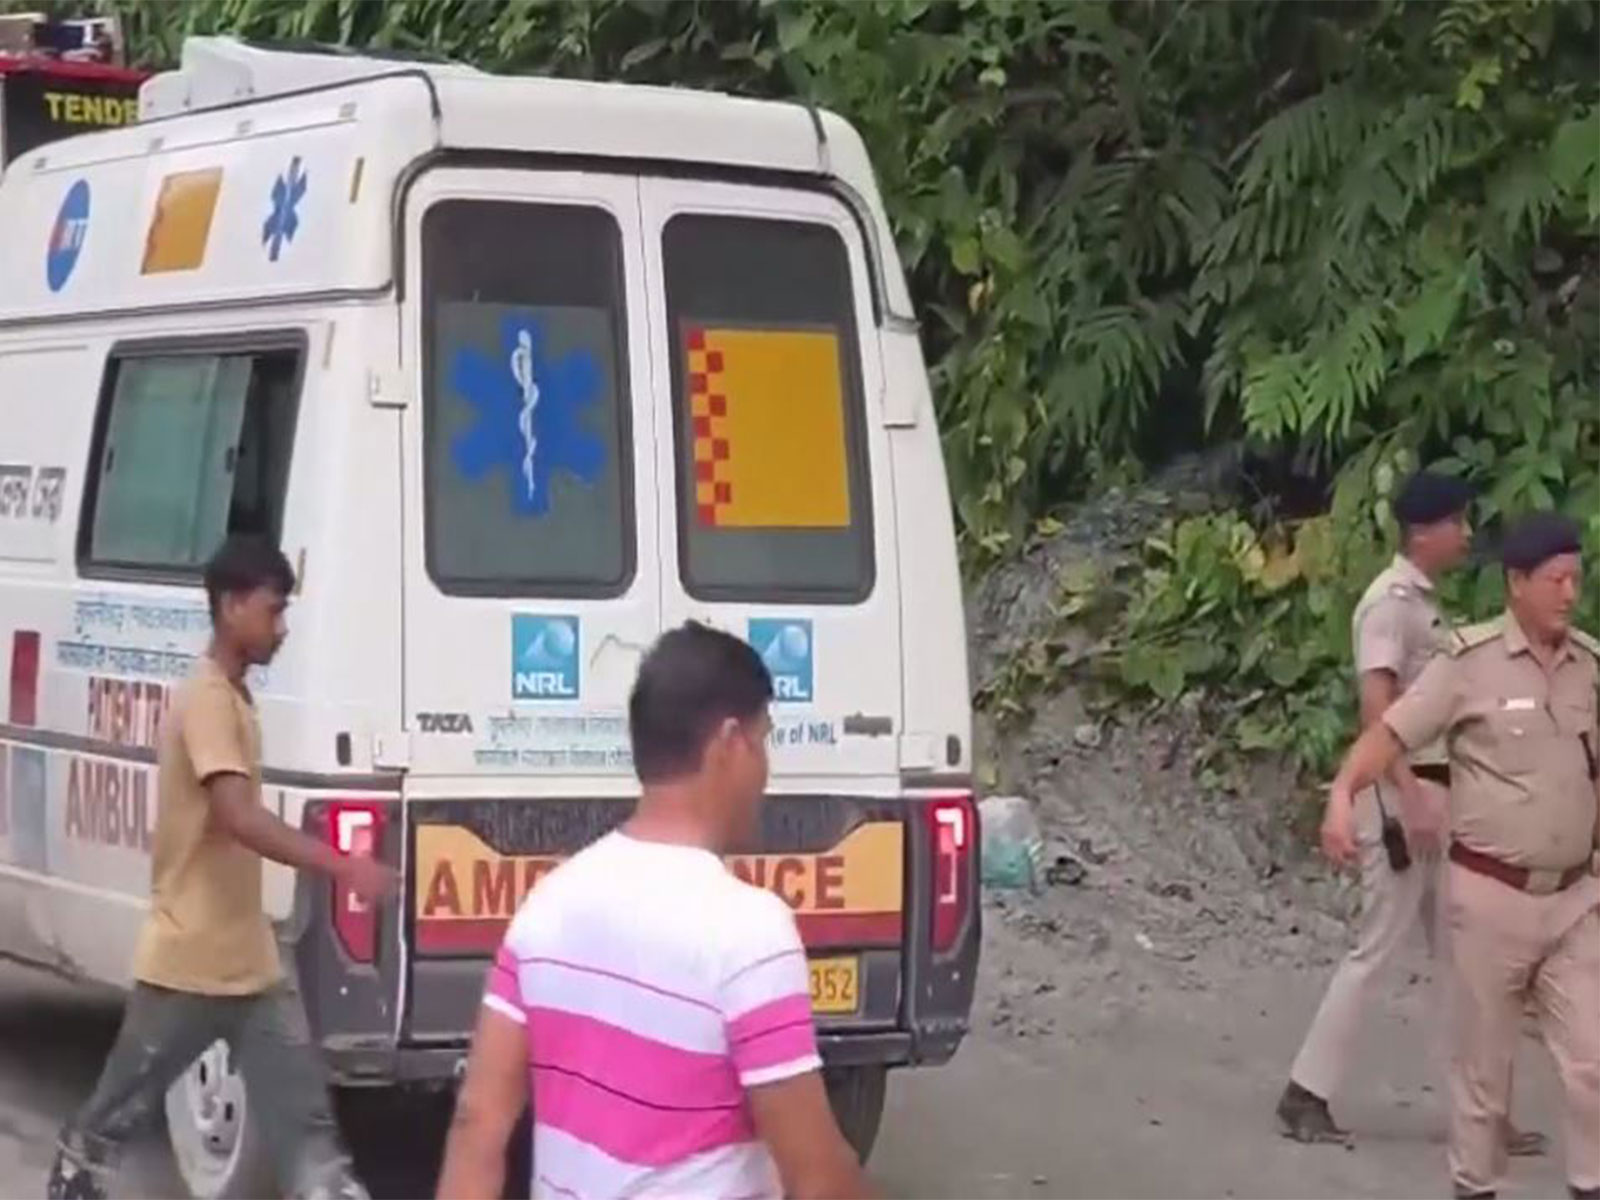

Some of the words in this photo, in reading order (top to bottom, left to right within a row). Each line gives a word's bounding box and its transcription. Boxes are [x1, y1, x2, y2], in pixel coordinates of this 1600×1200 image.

[515, 671, 576, 694] NRL
[416, 712, 474, 734] TATA
[789, 722, 804, 744] of
[808, 721, 838, 745] NRL
